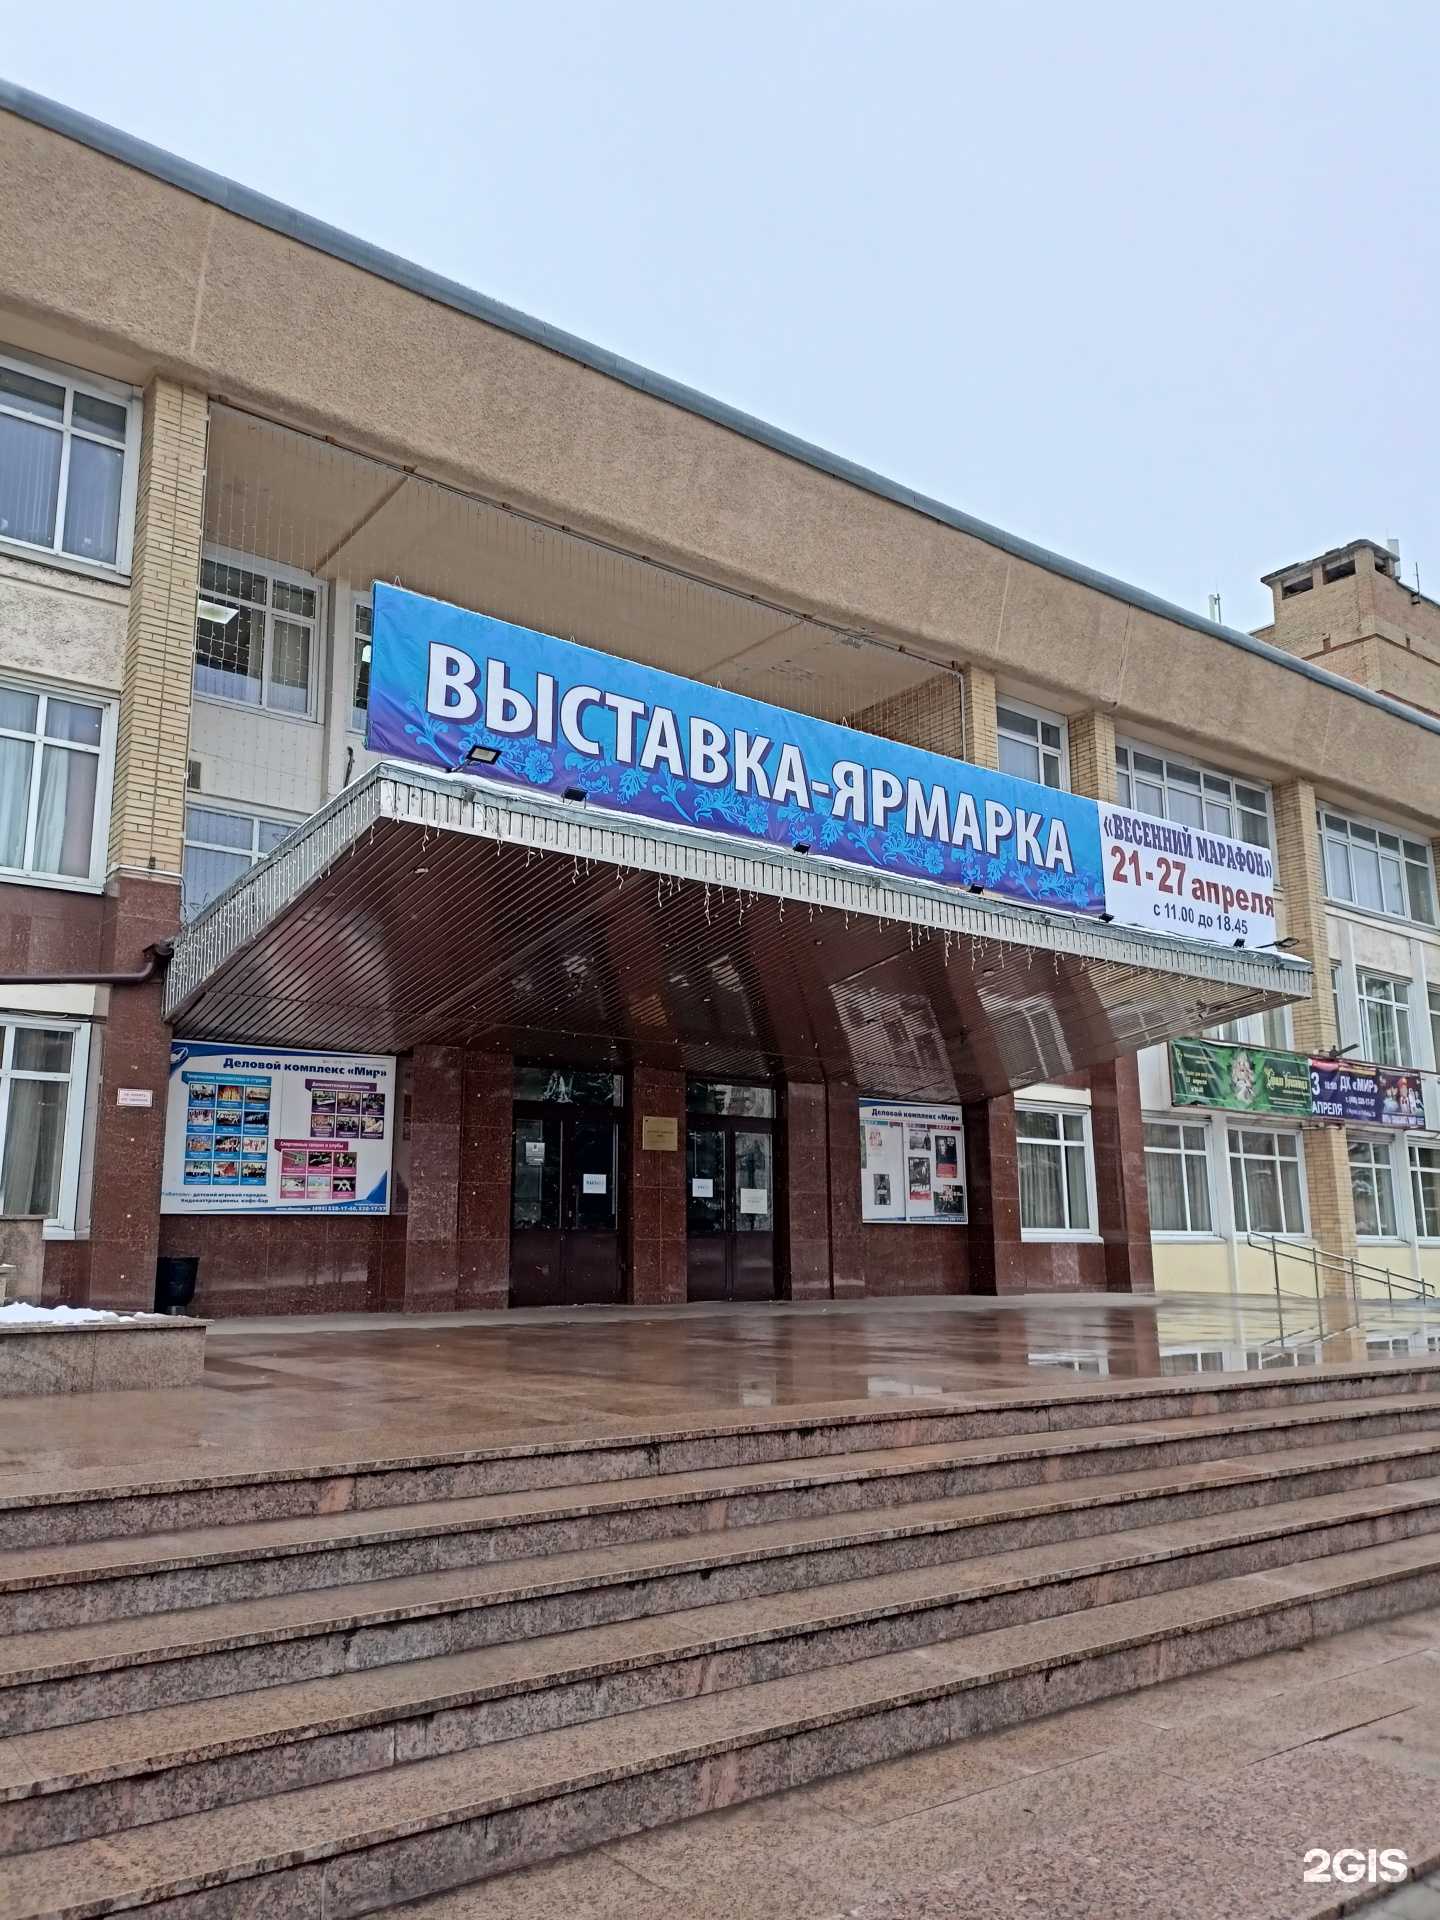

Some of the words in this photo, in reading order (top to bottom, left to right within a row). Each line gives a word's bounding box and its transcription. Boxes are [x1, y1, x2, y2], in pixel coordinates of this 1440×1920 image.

[427, 641, 1075, 875] ВЫСТАВКА-ЯРМАРКА
[1103, 813, 1194, 859] «ВЕСЕННИЙ
[1196, 836, 1272, 879] МАРАФОН»
[1110, 845, 1186, 897] 21-27
[1191, 877, 1275, 918] апреля
[1153, 903, 1161, 916] с
[1164, 902, 1194, 924] 11.00
[1198, 914, 1213, 929] до
[1216, 914, 1248, 935] 18.45
[223, 1057, 281, 1070] Деловой
[284, 1063, 345, 1075] комплекс
[347, 1066, 387, 1079] «Мир»
[1311, 1072, 1321, 1096] 3
[1340, 1075, 1352, 1093] ДК
[1352, 1078, 1378, 1094] «МИР»
[871, 1108, 903, 1118] Деловой
[903, 1112, 936, 1121] комплекс
[937, 1113, 960, 1123] «Мир»
[1311, 1100, 1343, 1117] АПРЕЛЯ
